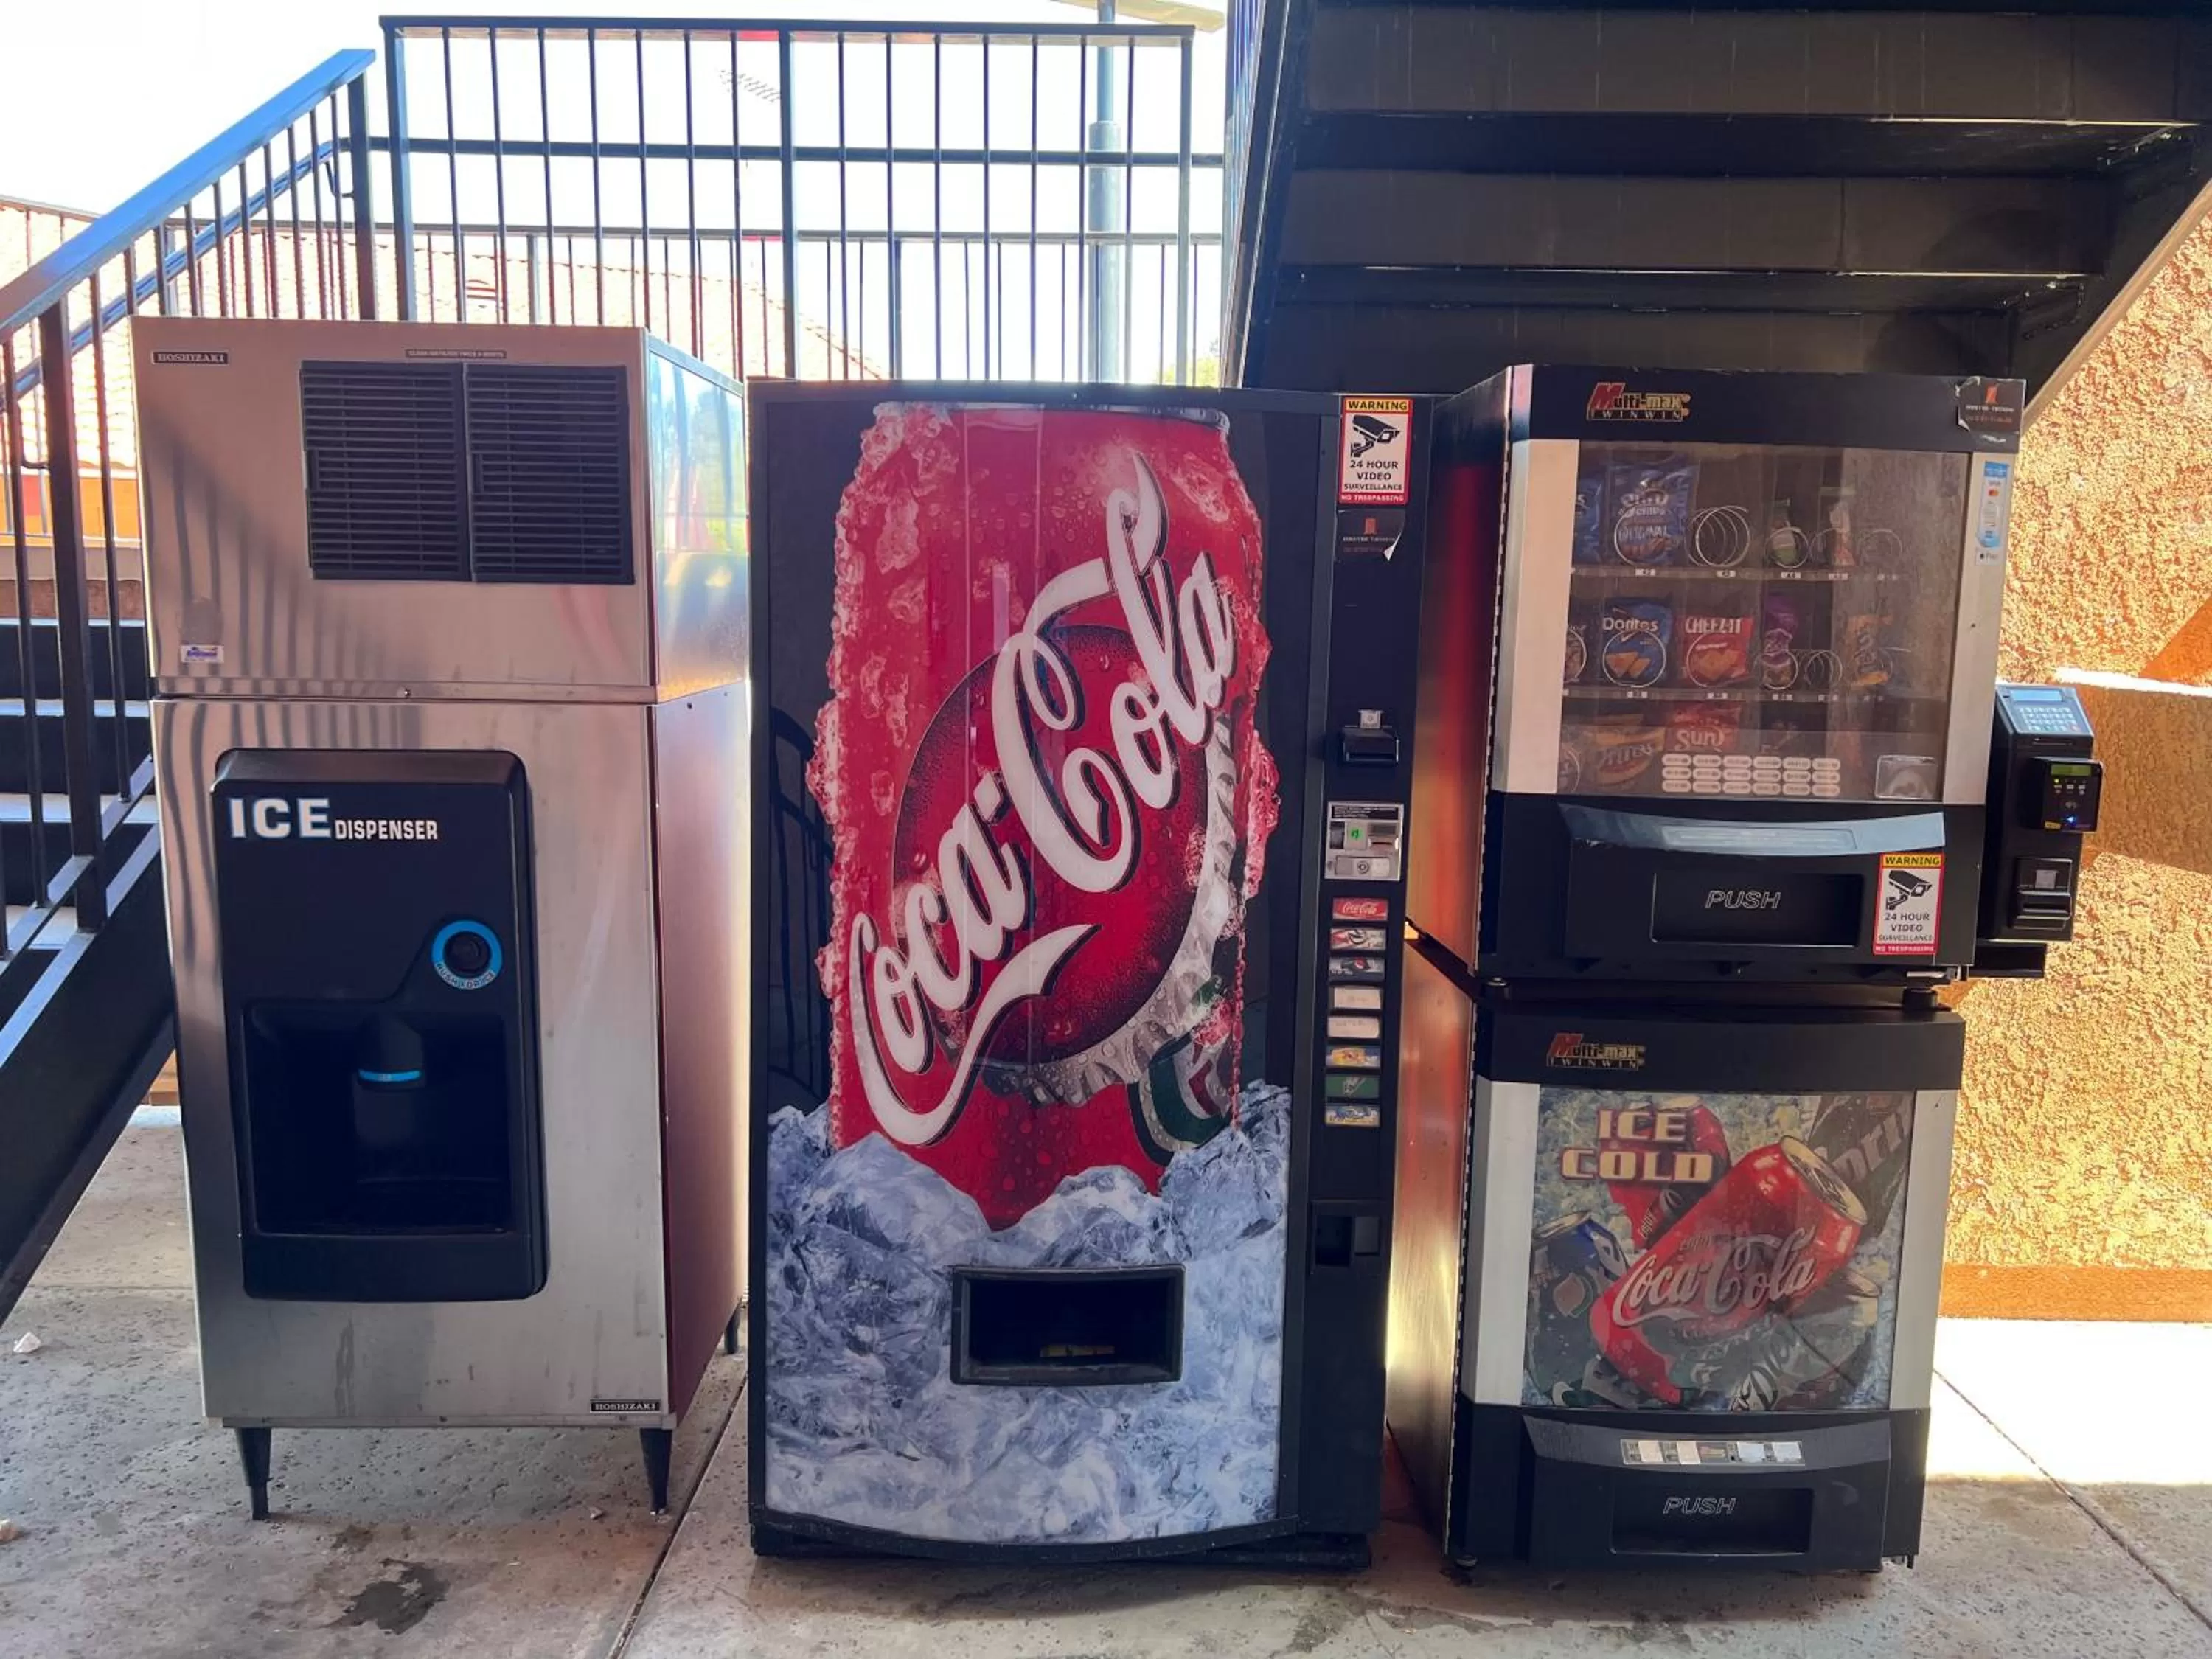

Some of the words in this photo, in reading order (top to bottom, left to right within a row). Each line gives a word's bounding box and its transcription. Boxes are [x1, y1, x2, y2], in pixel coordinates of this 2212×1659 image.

[1347, 400, 1408, 411] WARNING
[1349, 459, 1364, 469] 24
[1366, 460, 1399, 470] HOUR
[1356, 471, 1391, 481] VIDEO
[1343, 482, 1402, 491] SURVEILLANCE
[1354, 494, 1404, 502] TRESPASSING
[1601, 617, 1659, 632] Doritos
[849, 449, 1237, 1147] Coca-Cola
[229, 797, 332, 838] ICE
[334, 818, 439, 841] DISPENSER
[1885, 855, 1940, 865] WARNING
[1704, 889, 1782, 909] PUSH
[1885, 912, 1897, 921] 24
[1900, 912, 1930, 921] HOUR
[1891, 924, 1924, 933] VIDEO
[1598, 1109, 1688, 1141] ICE
[1561, 1149, 1713, 1182] COLD
[1613, 1224, 1817, 1327] Coca-Cola
[594, 1402, 656, 1411] HOSHIZAKI
[1663, 1496, 1737, 1514] PUSH
